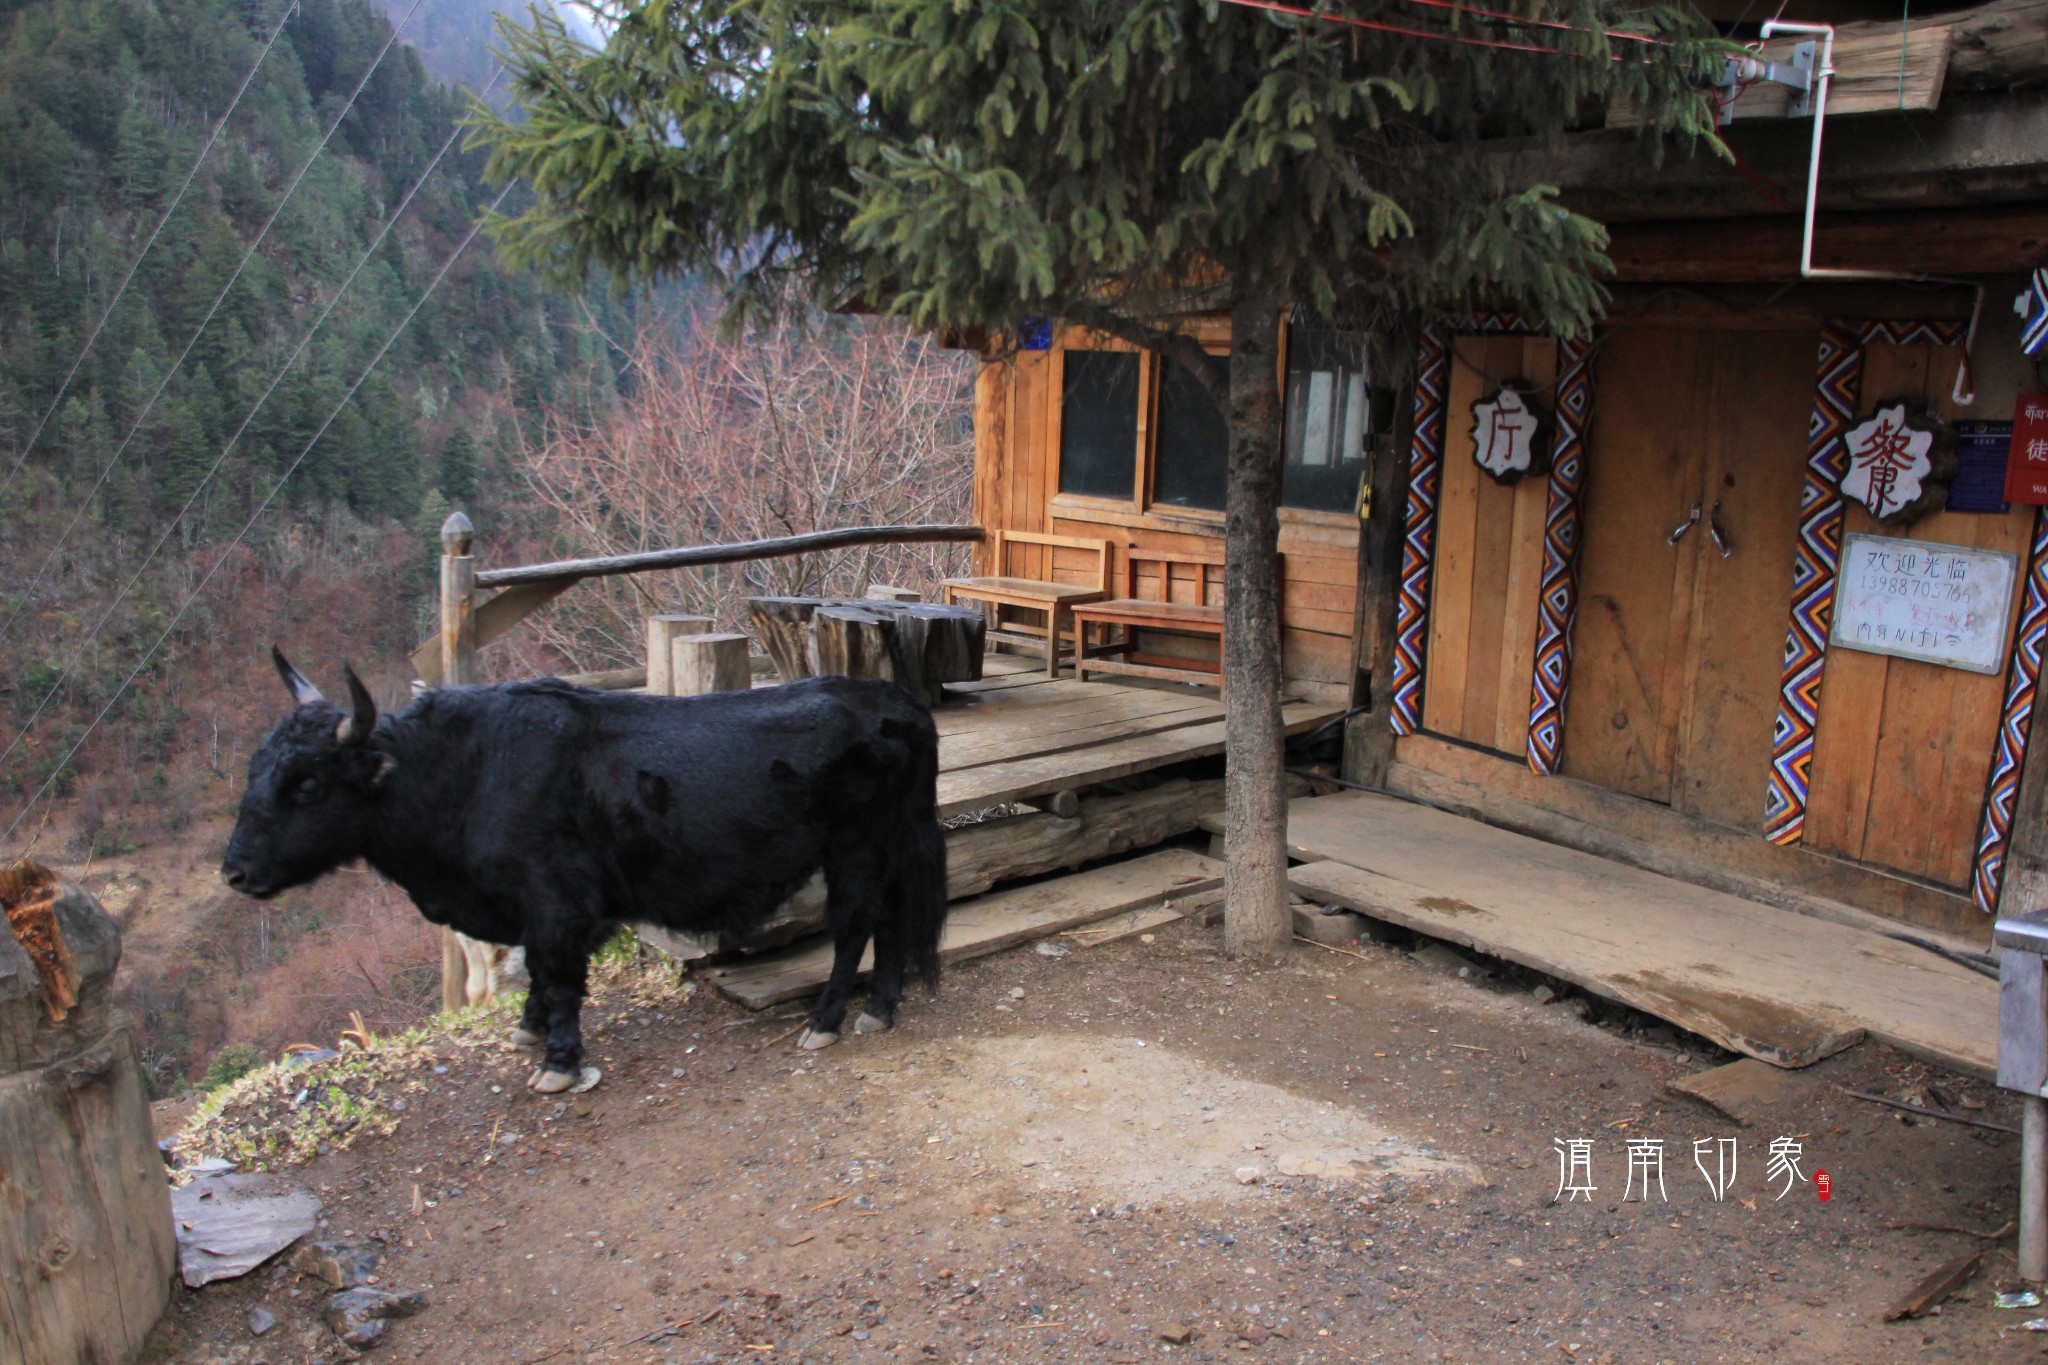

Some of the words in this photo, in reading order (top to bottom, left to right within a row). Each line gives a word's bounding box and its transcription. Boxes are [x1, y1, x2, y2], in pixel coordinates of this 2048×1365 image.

[1484, 407, 1522, 463] 厅
[2026, 438, 2048, 461] 徒
[1854, 418, 1916, 515] 餐
[1863, 552, 1967, 581] 欢迎光临
[1860, 575, 1971, 603] 13988705766
